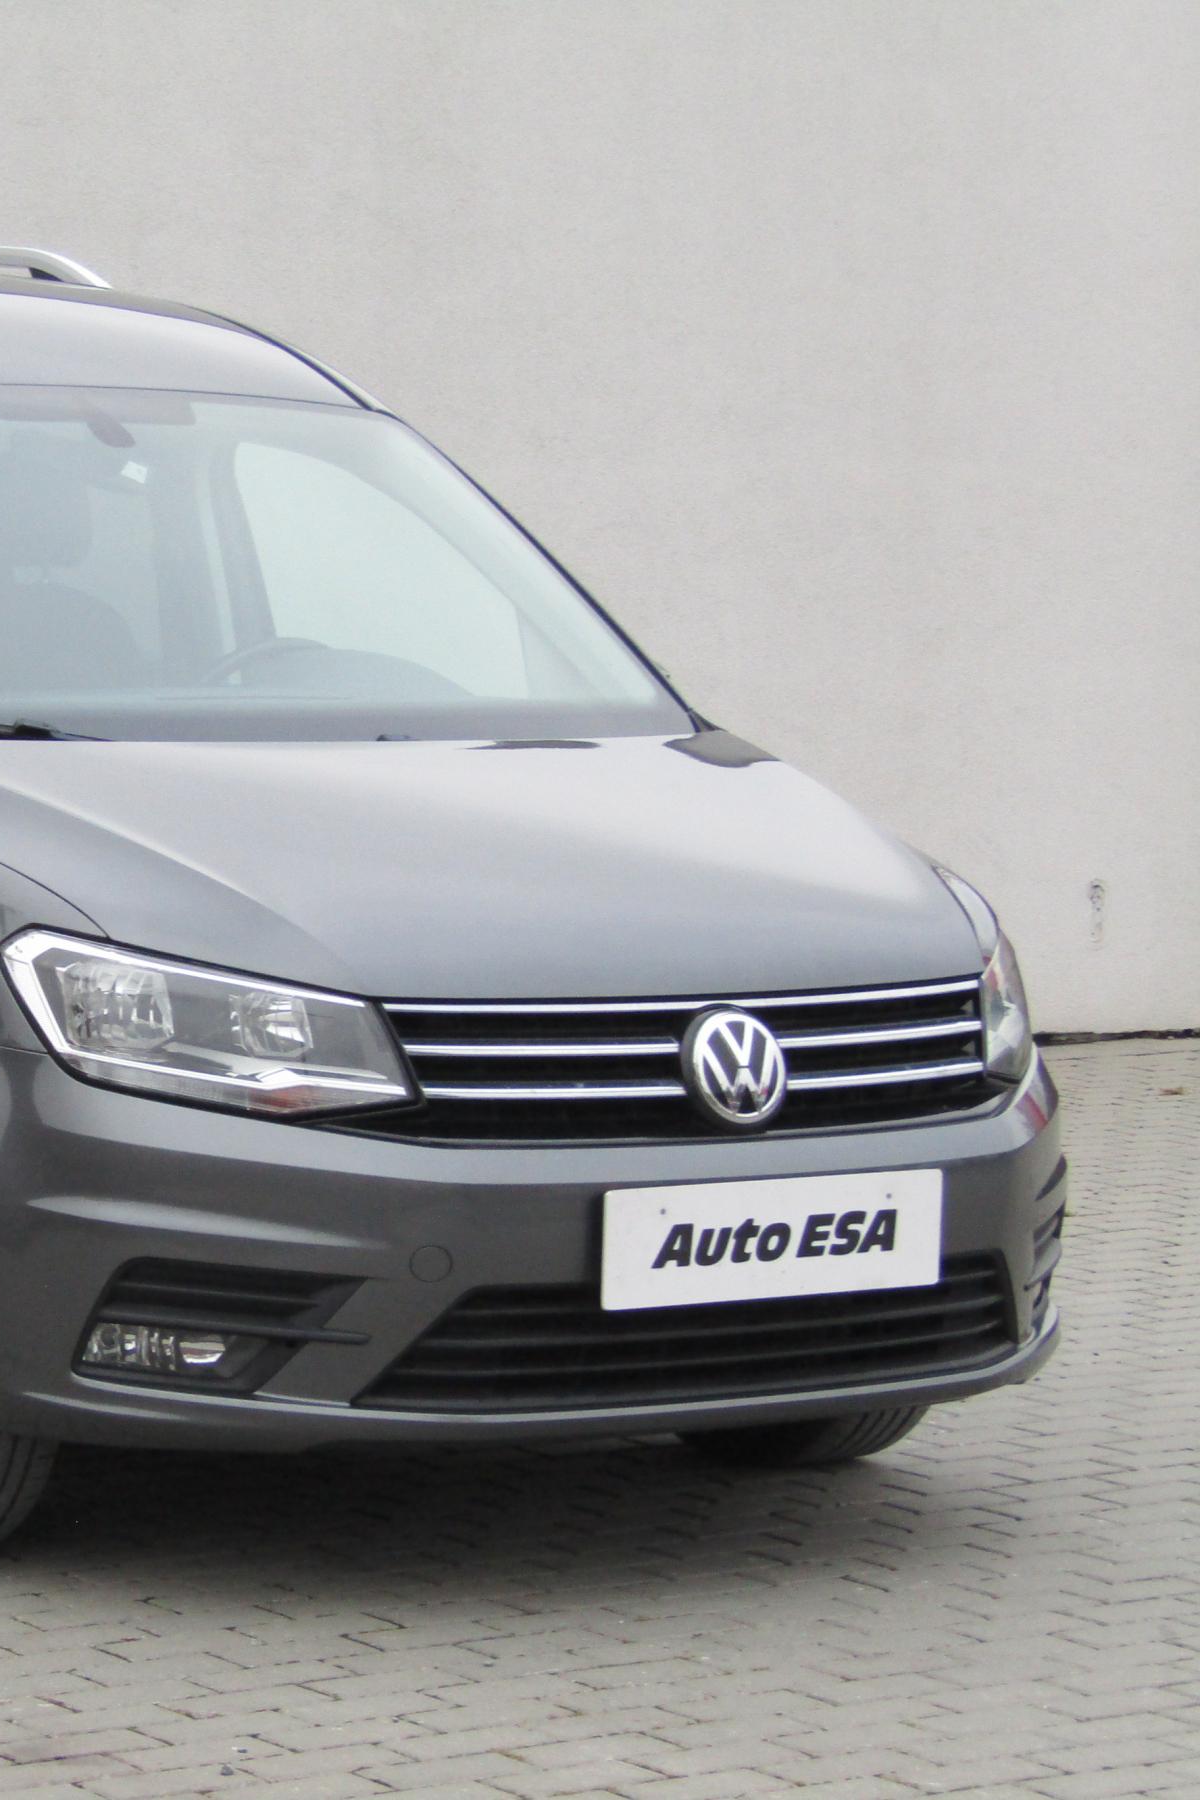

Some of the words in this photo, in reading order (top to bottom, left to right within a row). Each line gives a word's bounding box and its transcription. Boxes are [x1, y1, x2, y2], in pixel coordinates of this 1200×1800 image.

[696, 1014, 784, 1119] VW
[651, 1218, 792, 1270] Auto
[795, 1208, 898, 1259] ESA
